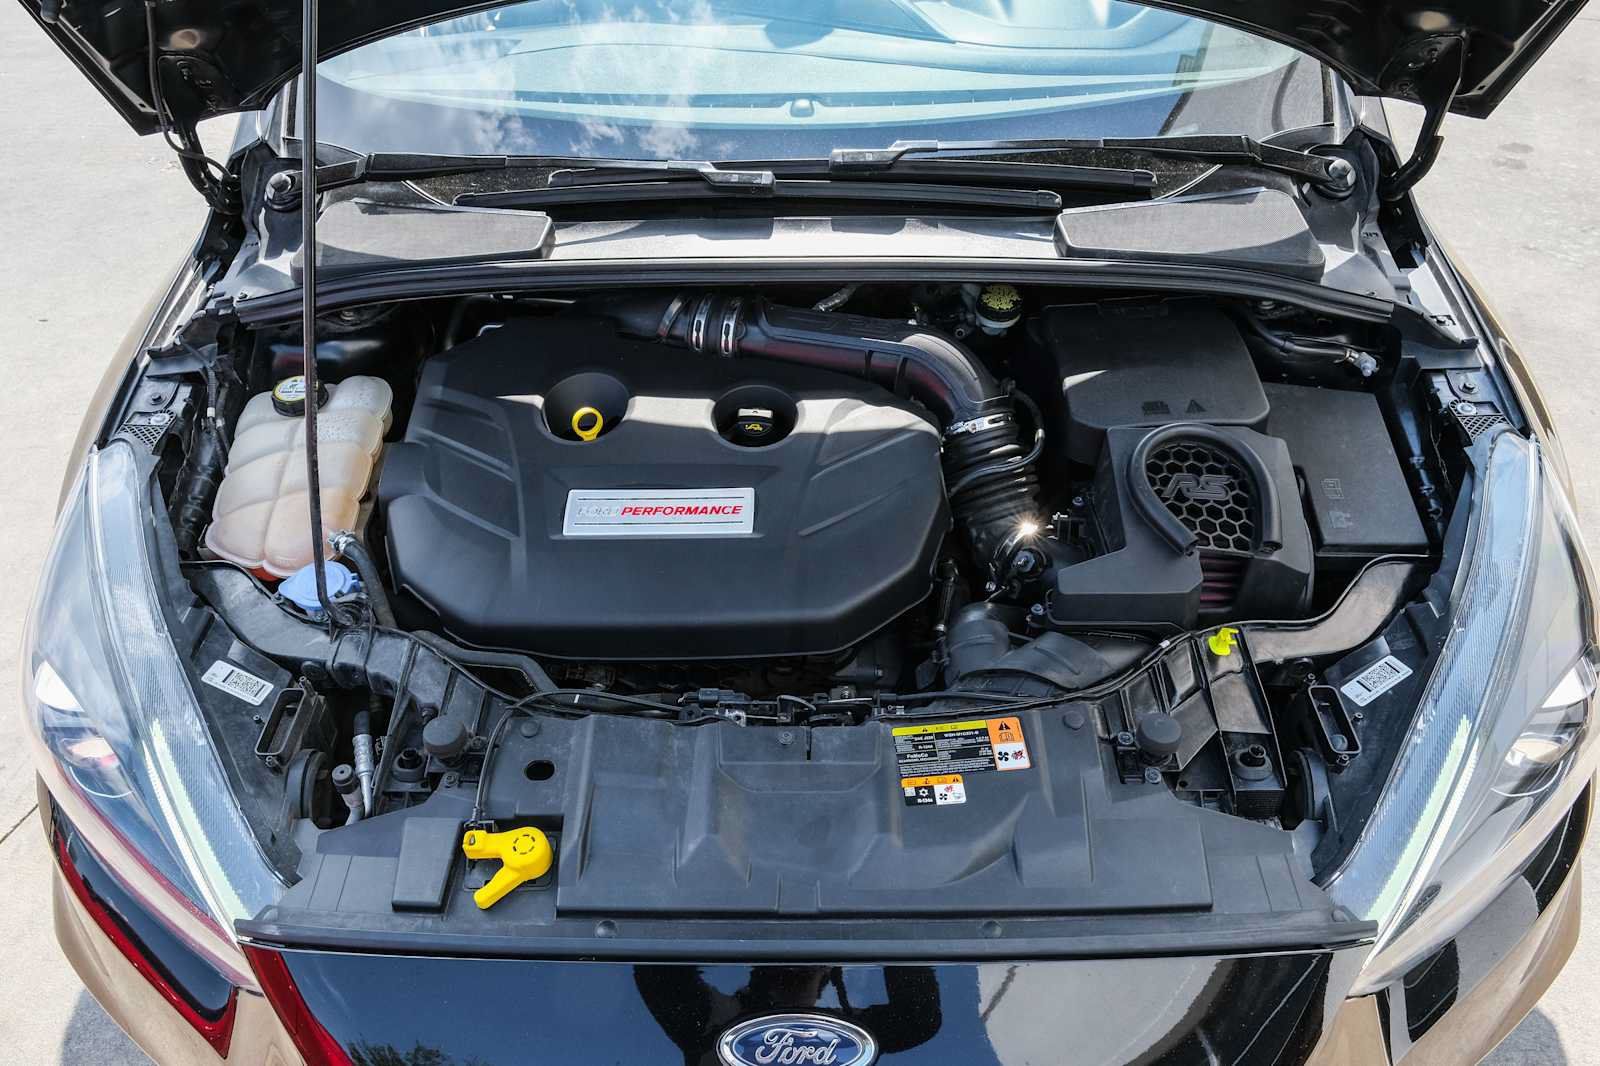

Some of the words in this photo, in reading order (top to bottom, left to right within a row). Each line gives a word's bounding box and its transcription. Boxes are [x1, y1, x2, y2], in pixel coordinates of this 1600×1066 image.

[1161, 473, 1232, 500] RS
[621, 505, 744, 516] PERFORMANCE
[755, 1028, 841, 1065] Ford
